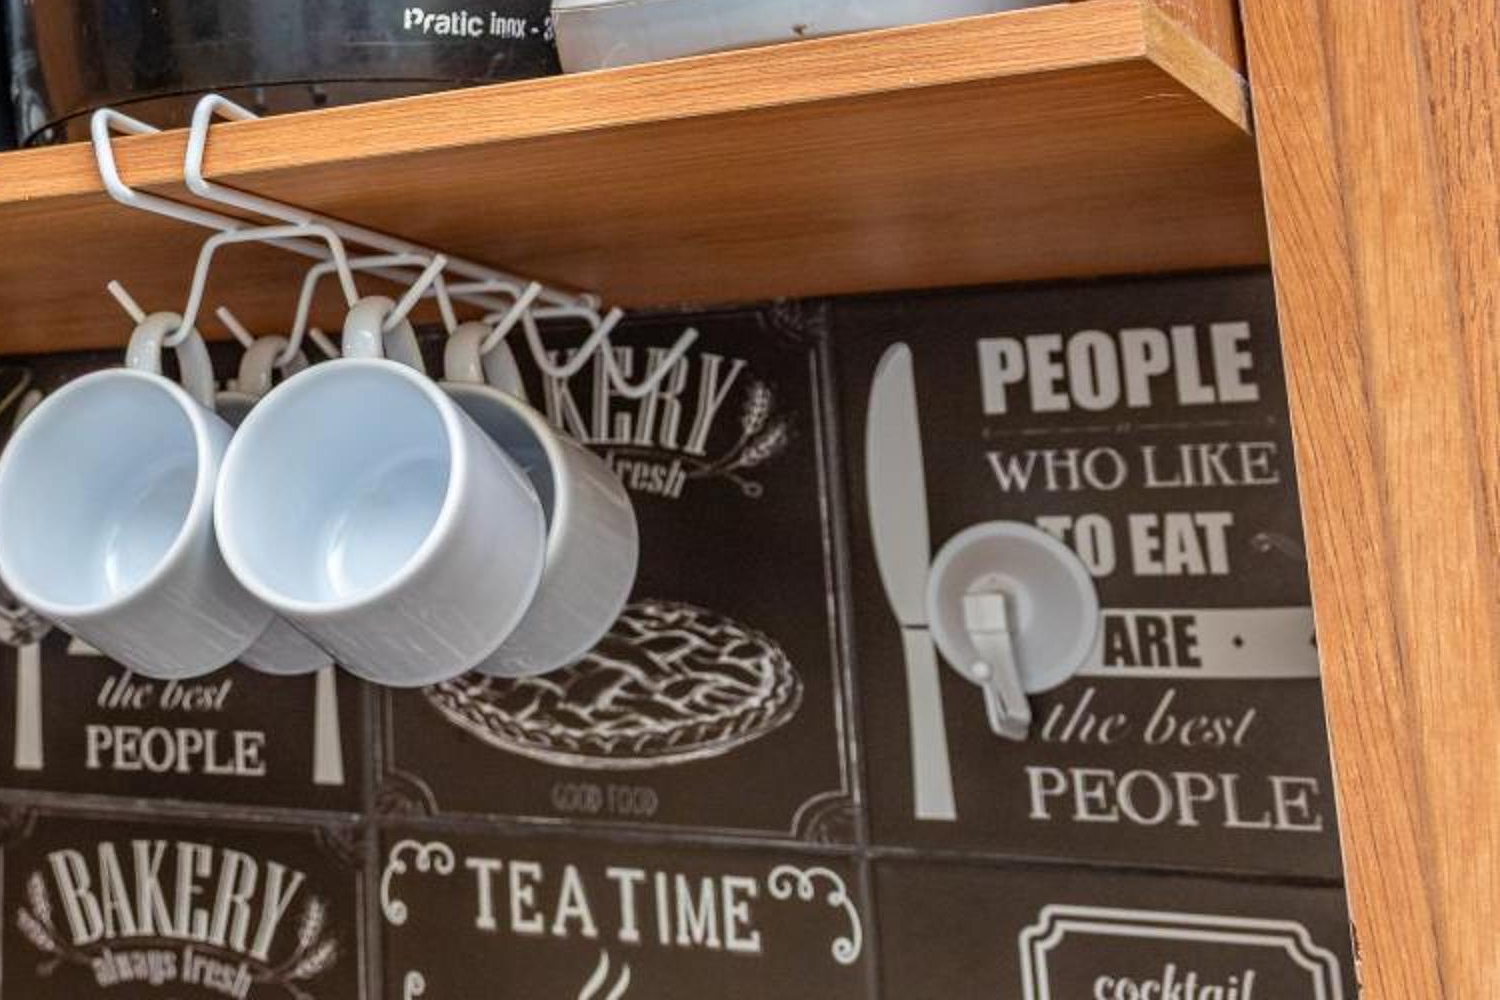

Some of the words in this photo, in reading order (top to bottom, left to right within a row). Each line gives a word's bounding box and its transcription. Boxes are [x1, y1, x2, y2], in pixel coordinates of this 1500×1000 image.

[403, 7, 485, 38] Pratic
[977, 321, 1260, 416] PEOPLE
[543, 345, 748, 457] KERY
[986, 446, 1129, 493] WHO
[1143, 441, 1281, 489] LIKE
[1127, 511, 1235, 576] EAT
[1102, 614, 1203, 669] ARE
[97, 667, 153, 710] the
[160, 678, 233, 712] best
[1041, 687, 1129, 748] the
[1144, 687, 1260, 749] best
[85, 723, 267, 777] PEOPLE
[1025, 764, 1324, 833] PEOPLE
[47, 838, 307, 962] BAKERY
[183, 945, 253, 999] fresh
